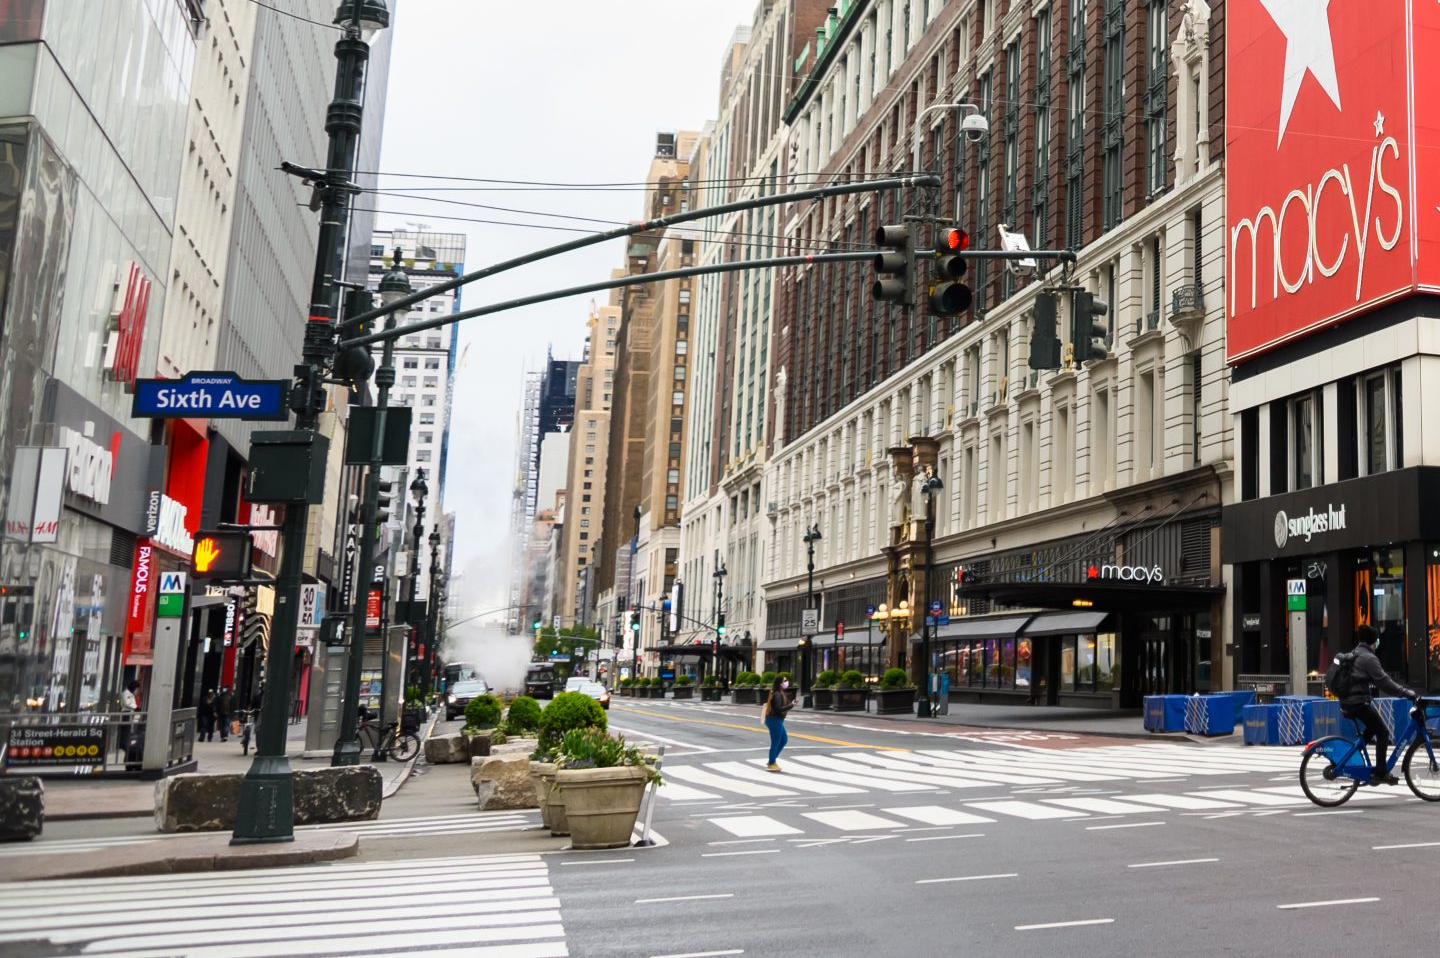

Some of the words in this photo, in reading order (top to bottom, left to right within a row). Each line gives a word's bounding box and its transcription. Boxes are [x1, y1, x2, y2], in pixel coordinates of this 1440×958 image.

[1231, 110, 1403, 318] macy's
[156, 389, 212, 408] Sixth
[218, 390, 261, 409] Ave
[147, 491, 160, 533] verizon
[1289, 506, 1328, 542] sunglass
[1328, 504, 1346, 530] hut
[346, 524, 356, 562] KAY
[136, 546, 152, 593] FAMOUS
[1102, 564, 1163, 584] macy's
[303, 588, 315, 606] 30
[10, 738, 44, 746] Station
[24, 729, 87, 738] Street-Herald
[90, 728, 102, 738] Sq
